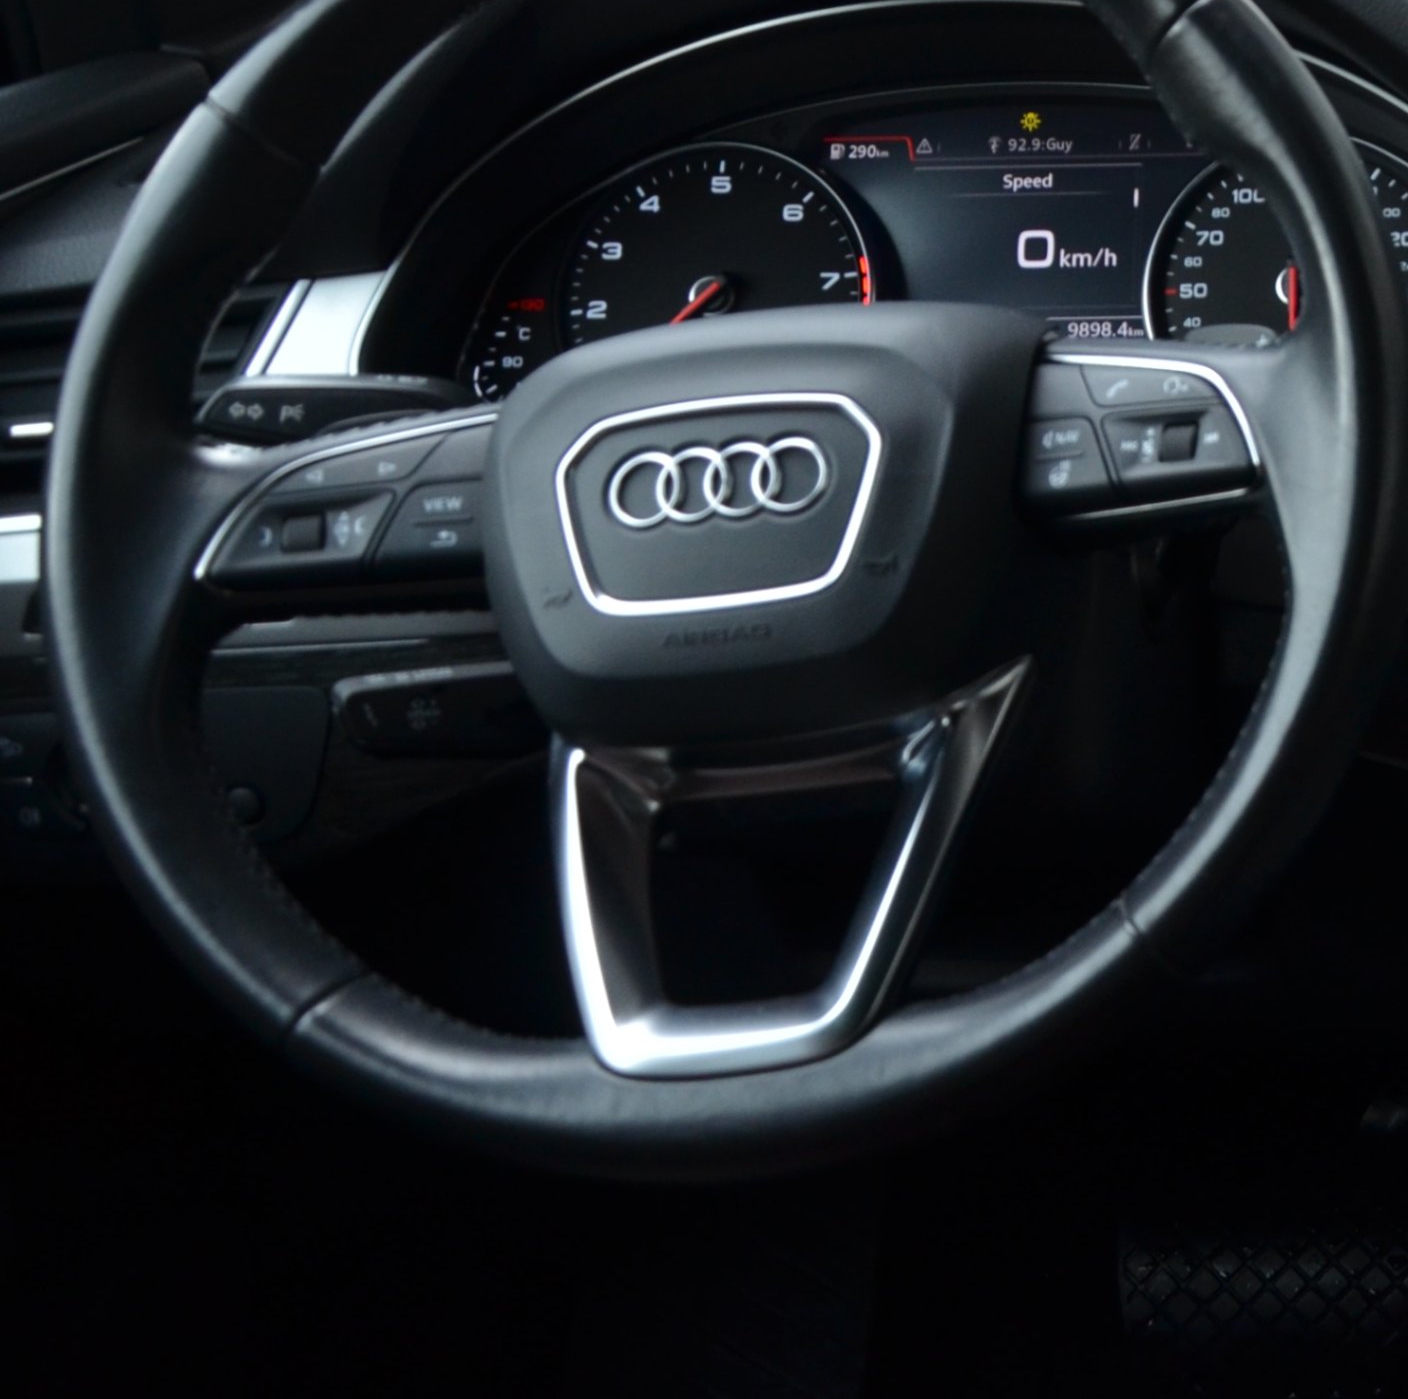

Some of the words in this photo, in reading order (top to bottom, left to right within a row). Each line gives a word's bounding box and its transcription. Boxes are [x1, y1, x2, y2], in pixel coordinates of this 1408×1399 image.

[711, 176, 731, 194] 5
[1003, 173, 1053, 191] Speed
[639, 195, 660, 213] 4
[783, 204, 803, 221] 6
[1211, 207, 1230, 218] 80
[1196, 230, 1224, 246] 70
[601, 242, 622, 260] 3
[1059, 248, 1117, 269] km/h
[1184, 256, 1203, 267] 60
[819, 272, 840, 290] 7
[1179, 283, 1208, 299] 50
[586, 301, 606, 319] 2
[1183, 317, 1201, 328] 40
[502, 356, 523, 368] 90
[422, 495, 463, 512] VIEW
